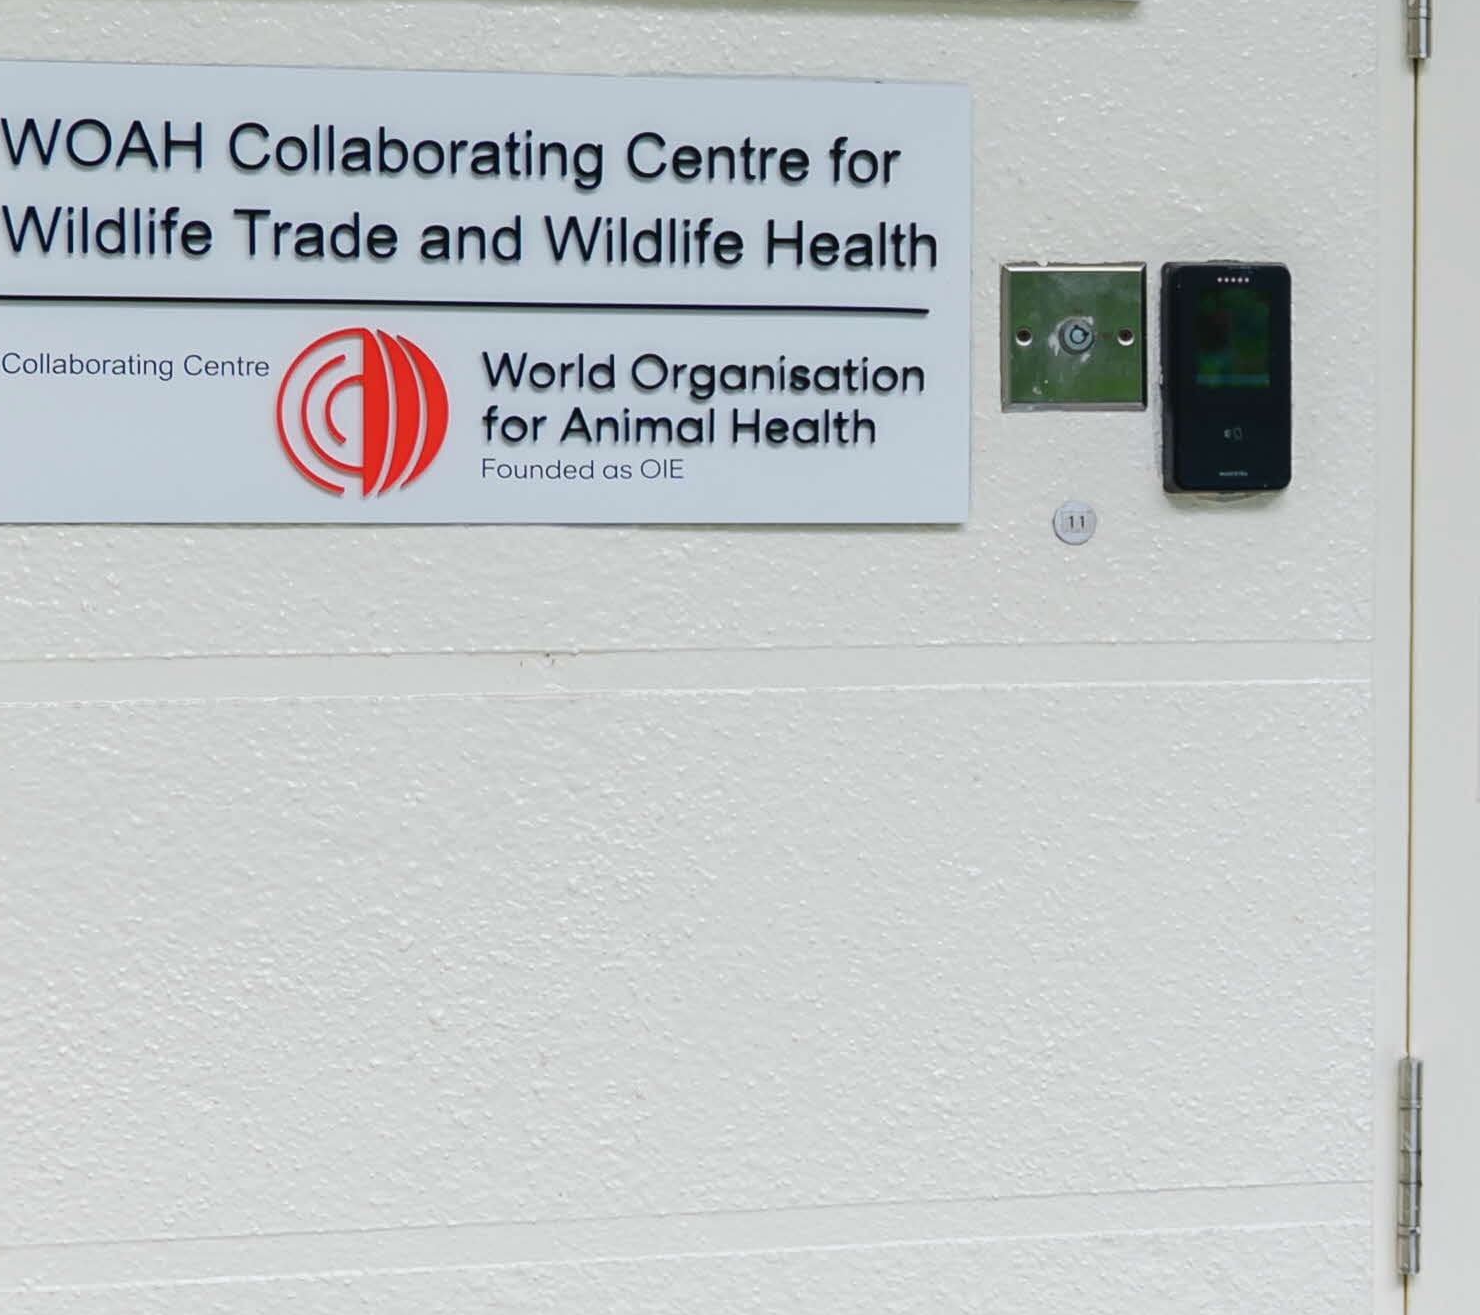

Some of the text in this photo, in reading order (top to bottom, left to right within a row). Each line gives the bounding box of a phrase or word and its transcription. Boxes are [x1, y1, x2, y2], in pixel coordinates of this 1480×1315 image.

[0, 116, 903, 192] WOAH Collaborating Centre for
[0, 204, 938, 270] Wildlife Trade and Wildlife Health
[0, 351, 271, 383] Collaborating Centre
[480, 350, 926, 406] World Organisation
[480, 403, 877, 449] for Animal Health
[481, 456, 684, 481] Founded as OIE
[1068, 515, 1086, 530] 11
